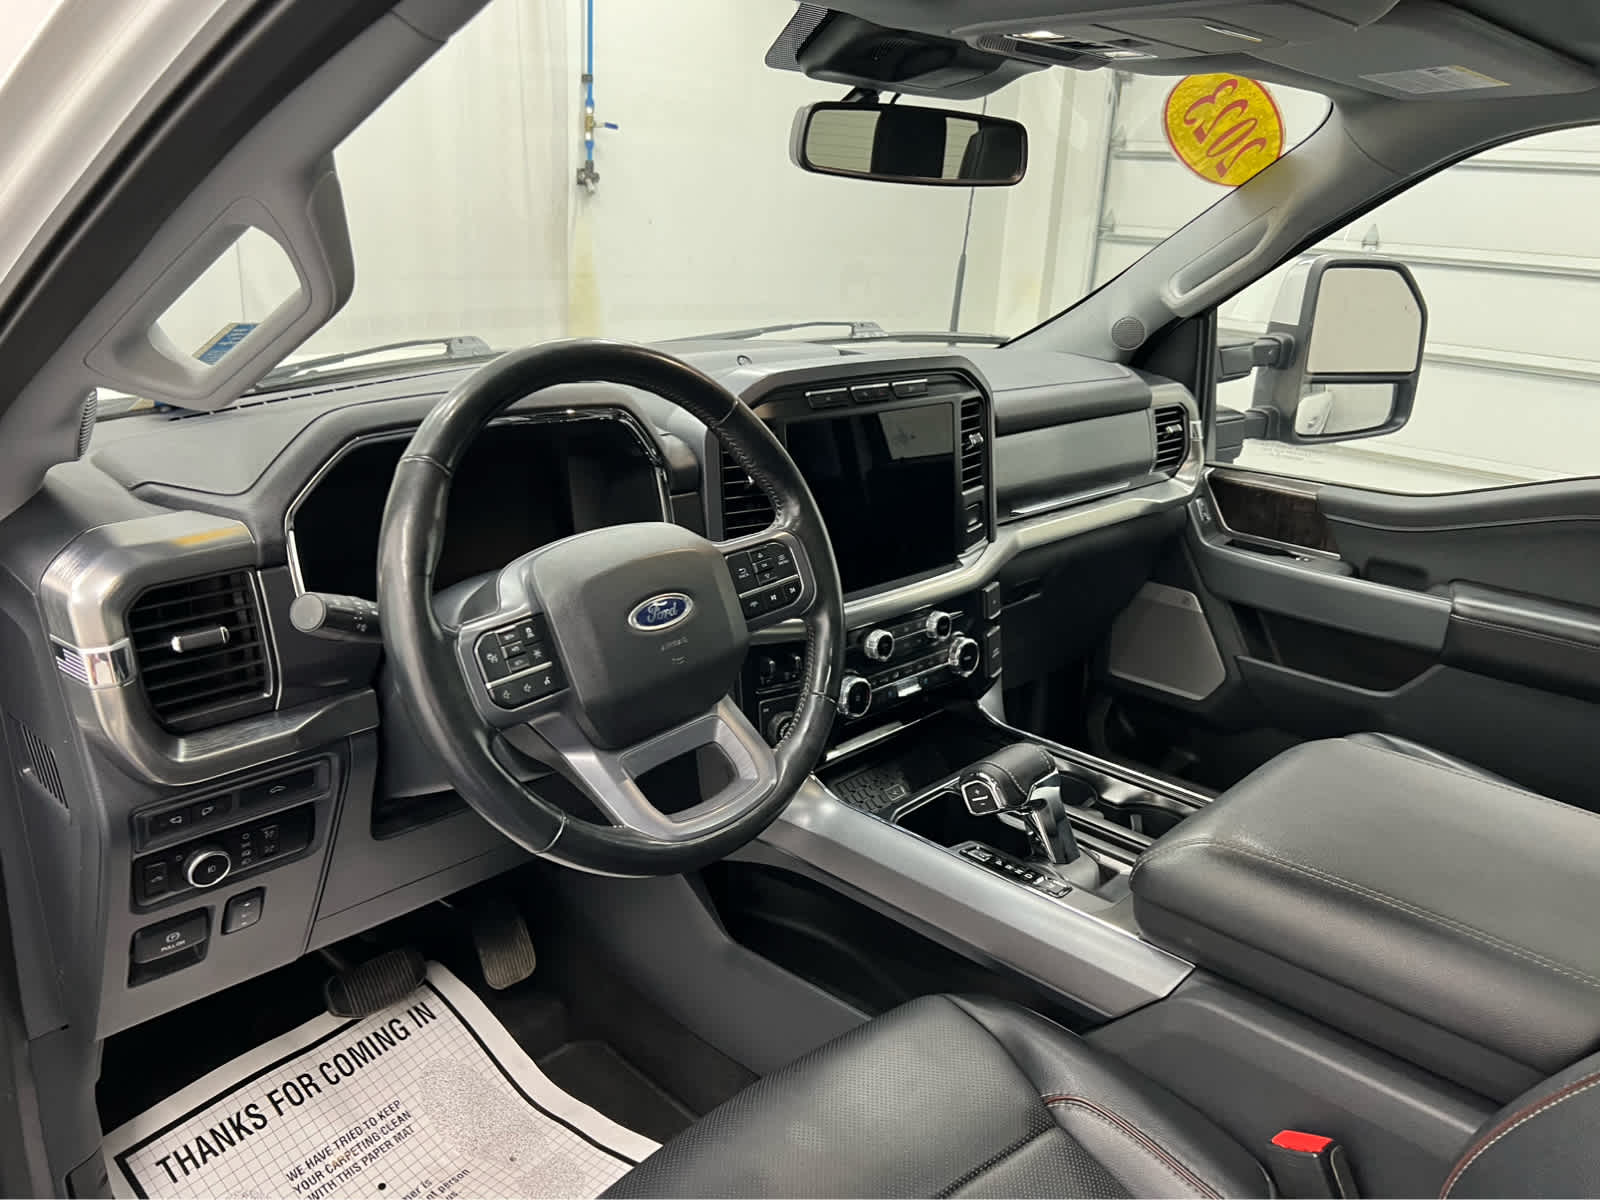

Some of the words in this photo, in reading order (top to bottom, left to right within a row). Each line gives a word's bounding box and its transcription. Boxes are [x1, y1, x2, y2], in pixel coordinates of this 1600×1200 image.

[647, 600, 678, 623] Ford
[154, 1103, 268, 1184] THANKS
[265, 1072, 323, 1117] FOR
[318, 1017, 412, 1086] COMING
[406, 1001, 437, 1029] IN
[286, 1164, 305, 1182] WE
[304, 1145, 335, 1170] HAVE
[332, 1125, 364, 1151] TRIED
[362, 1116, 378, 1131] TO
[376, 1099, 401, 1121] KEEP
[293, 1170, 326, 1195] YOUR
[324, 1131, 382, 1175] CARPETING
[379, 1110, 412, 1136] CLEAN
[307, 1180, 338, 1200] WITH
[335, 1162, 363, 1184] THIS
[360, 1139, 395, 1167] PAPER
[393, 1123, 416, 1145] MAT
[437, 1168, 471, 1194] person
